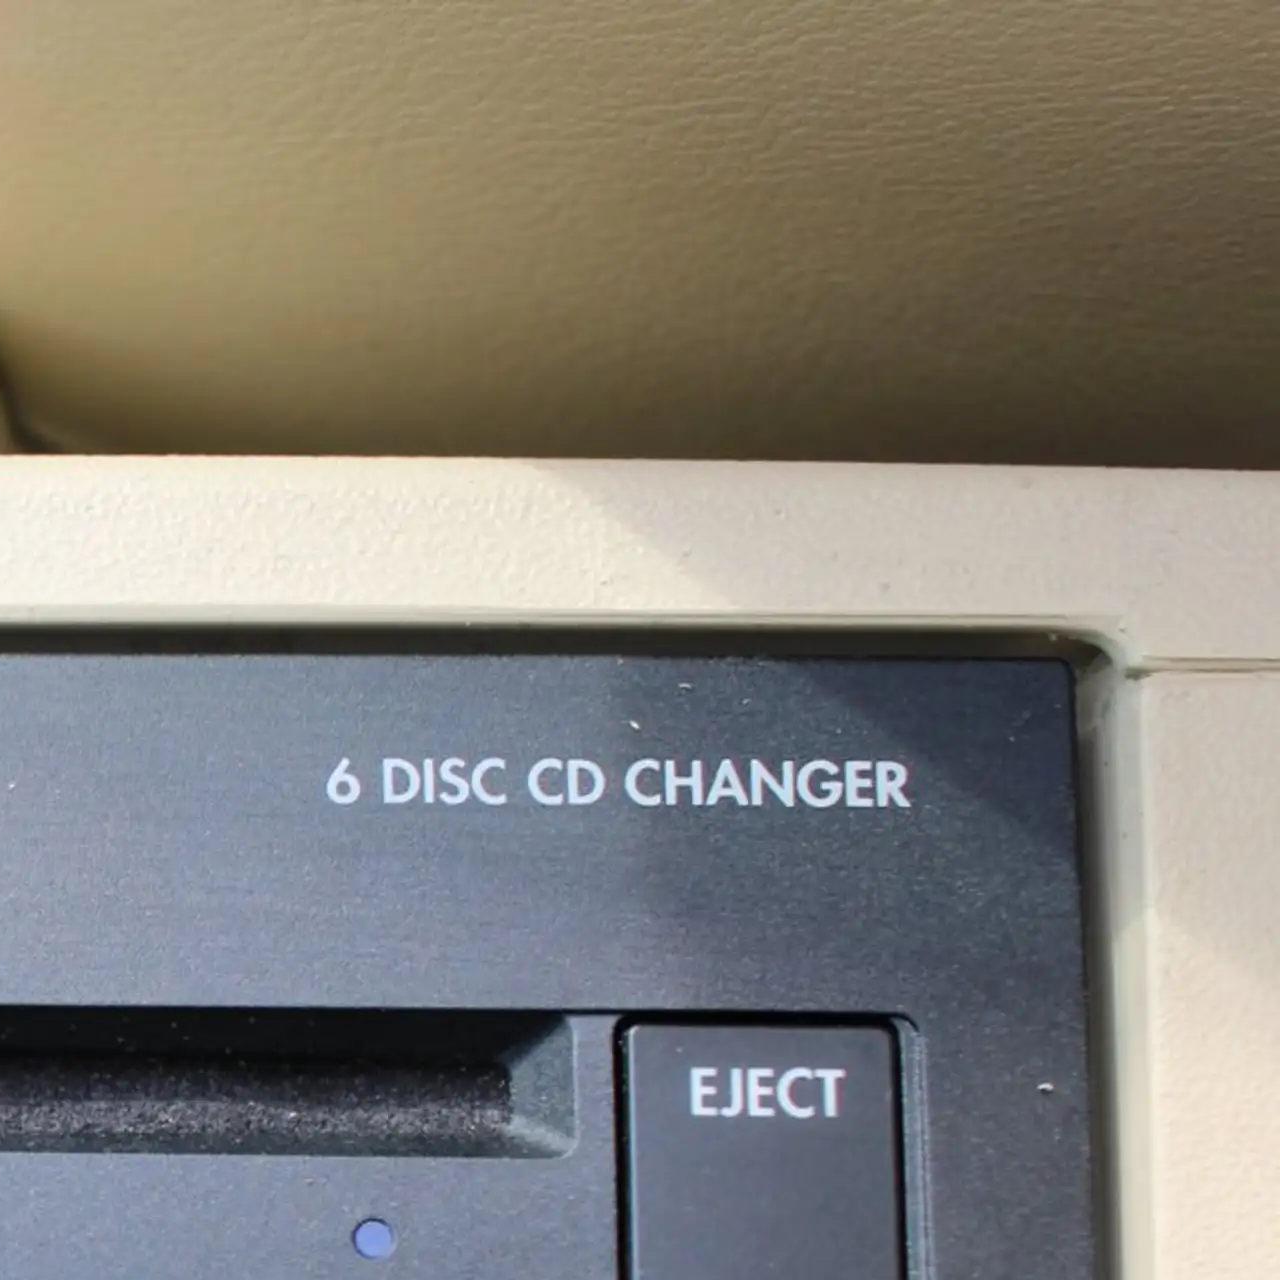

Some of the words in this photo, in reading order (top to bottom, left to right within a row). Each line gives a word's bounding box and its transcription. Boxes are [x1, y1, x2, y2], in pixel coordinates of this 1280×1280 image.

[325, 756, 362, 806] 6
[381, 756, 508, 806] DISC
[526, 757, 606, 807] CD
[624, 757, 912, 809] CHANGER
[688, 1065, 846, 1120] EJECT
